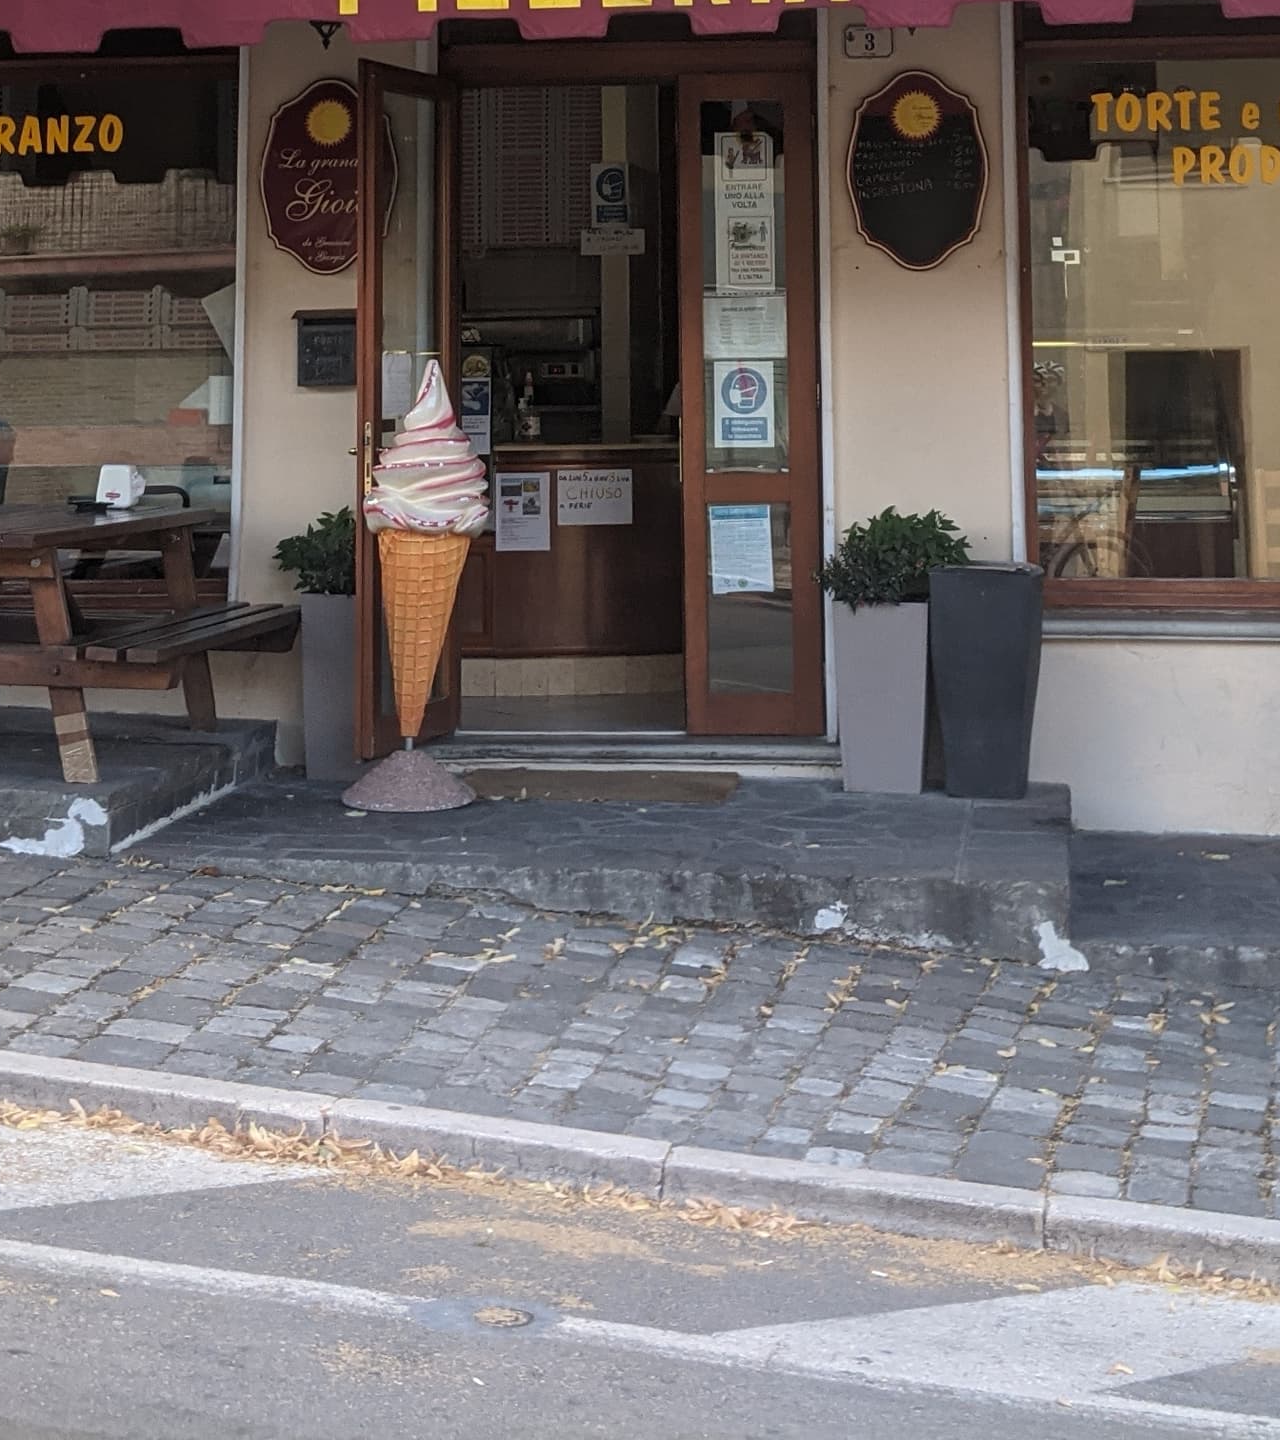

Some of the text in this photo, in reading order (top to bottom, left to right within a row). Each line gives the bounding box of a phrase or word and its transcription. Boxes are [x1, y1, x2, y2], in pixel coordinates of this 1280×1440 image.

[864, 32, 875, 51] 3
[1092, 90, 1221, 133] TORTE
[1242, 100, 1260, 131] e
[278, 148, 305, 168] La
[285, 177, 358, 222] Gioi
[566, 487, 622, 500] CHIUSO
